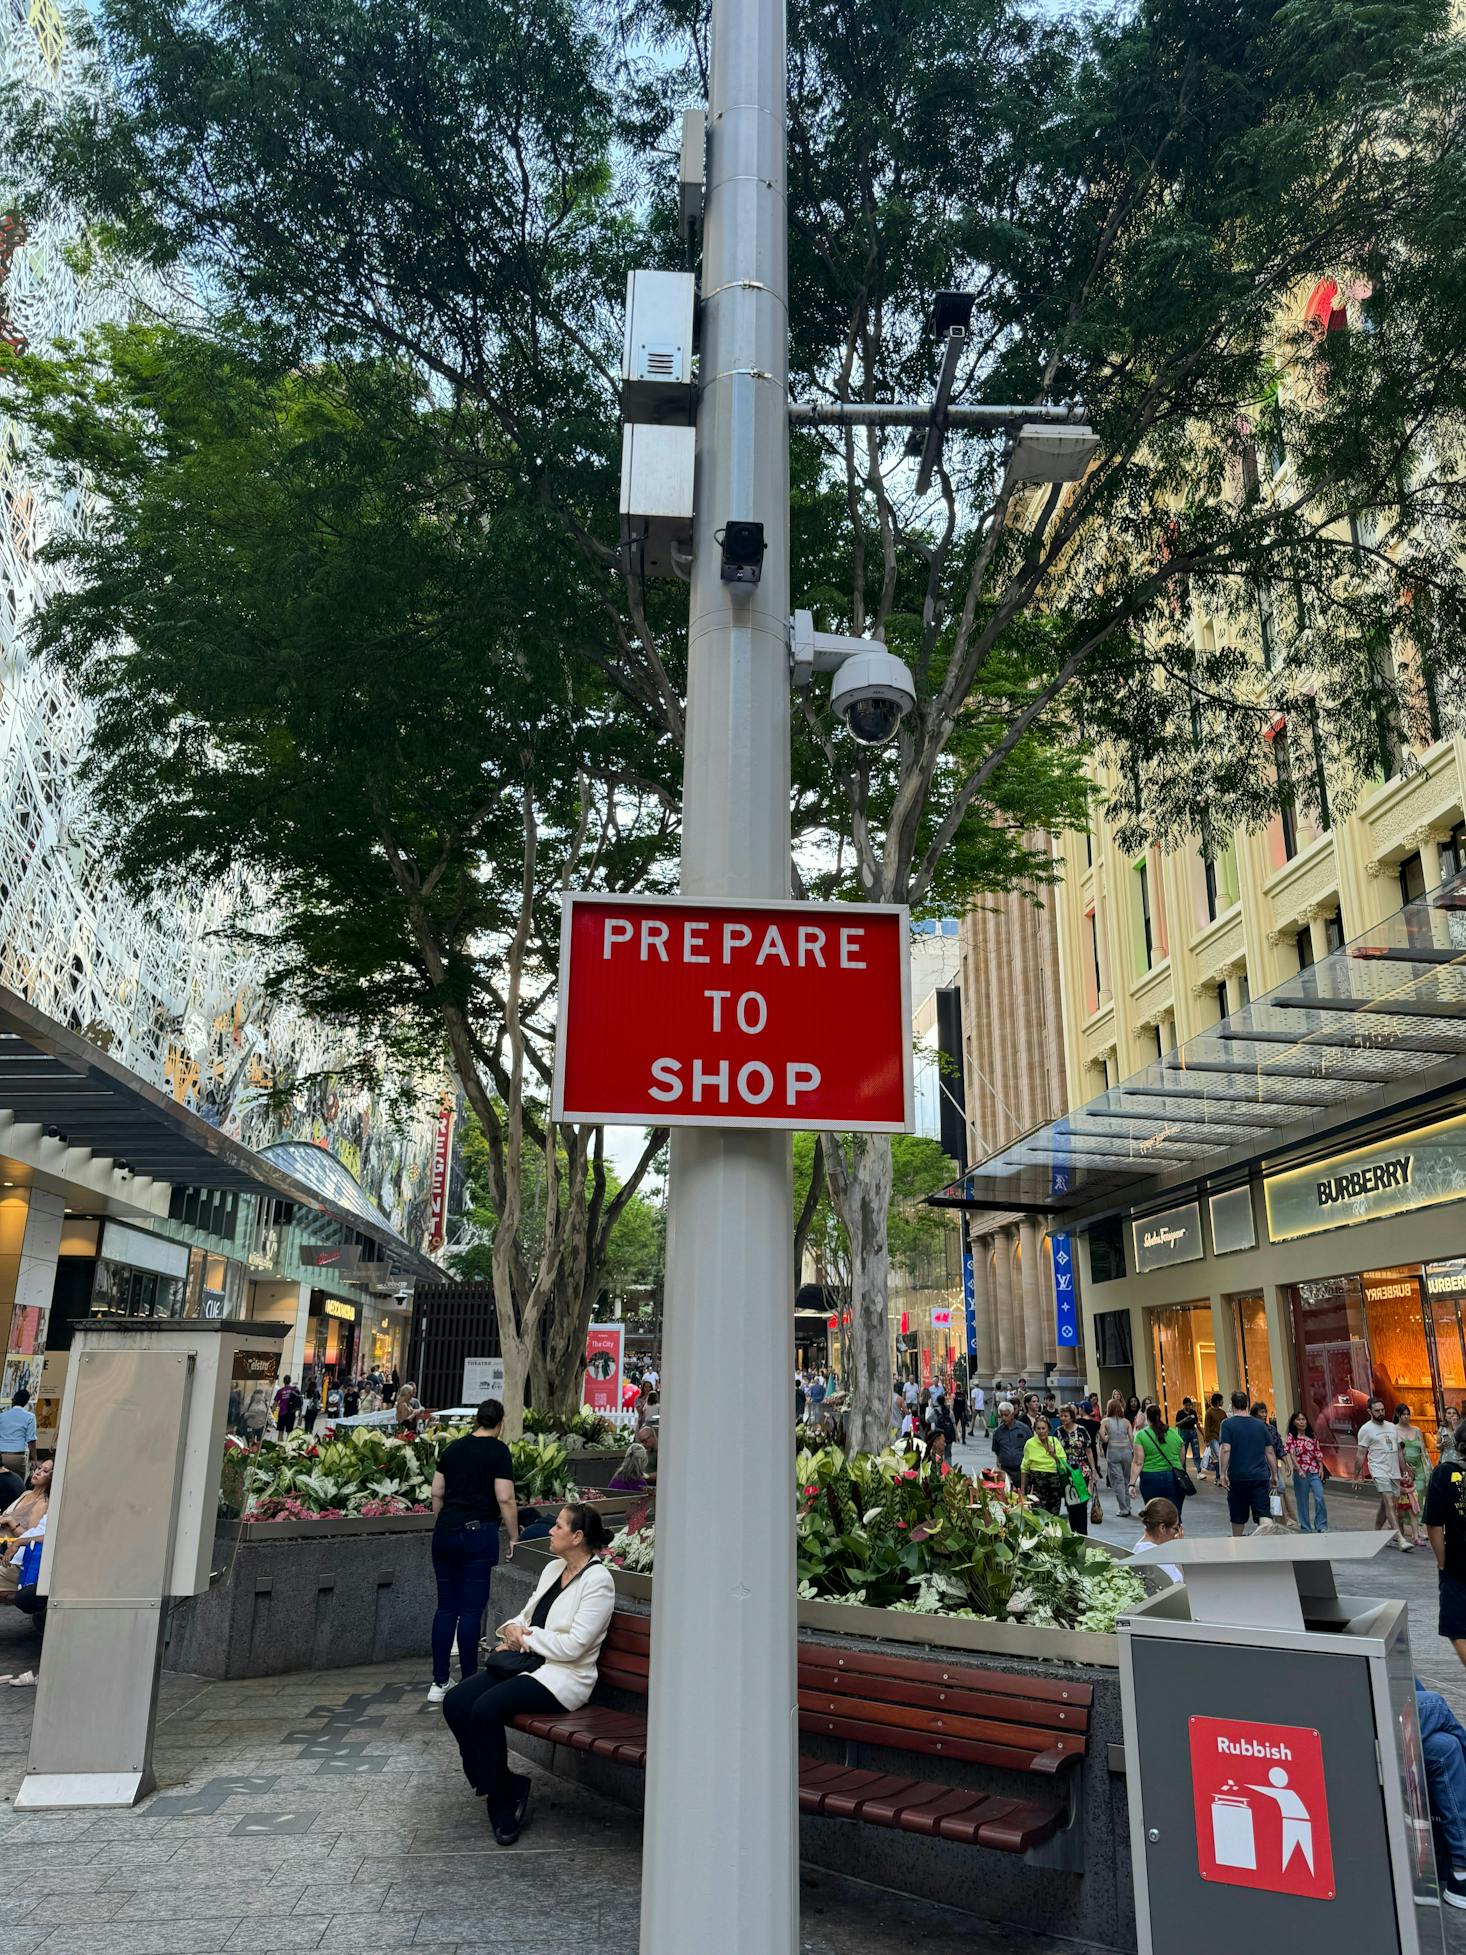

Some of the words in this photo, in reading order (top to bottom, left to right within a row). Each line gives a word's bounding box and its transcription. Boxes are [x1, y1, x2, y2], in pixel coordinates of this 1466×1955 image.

[603, 918, 867, 969] PREPARE
[704, 990, 767, 1034] TO
[648, 1057, 821, 1106] SHOP
[429, 1117, 447, 1234] REGENT
[1316, 1156, 1411, 1206] BURBERRY
[1217, 1736, 1292, 1761] Rubbish
